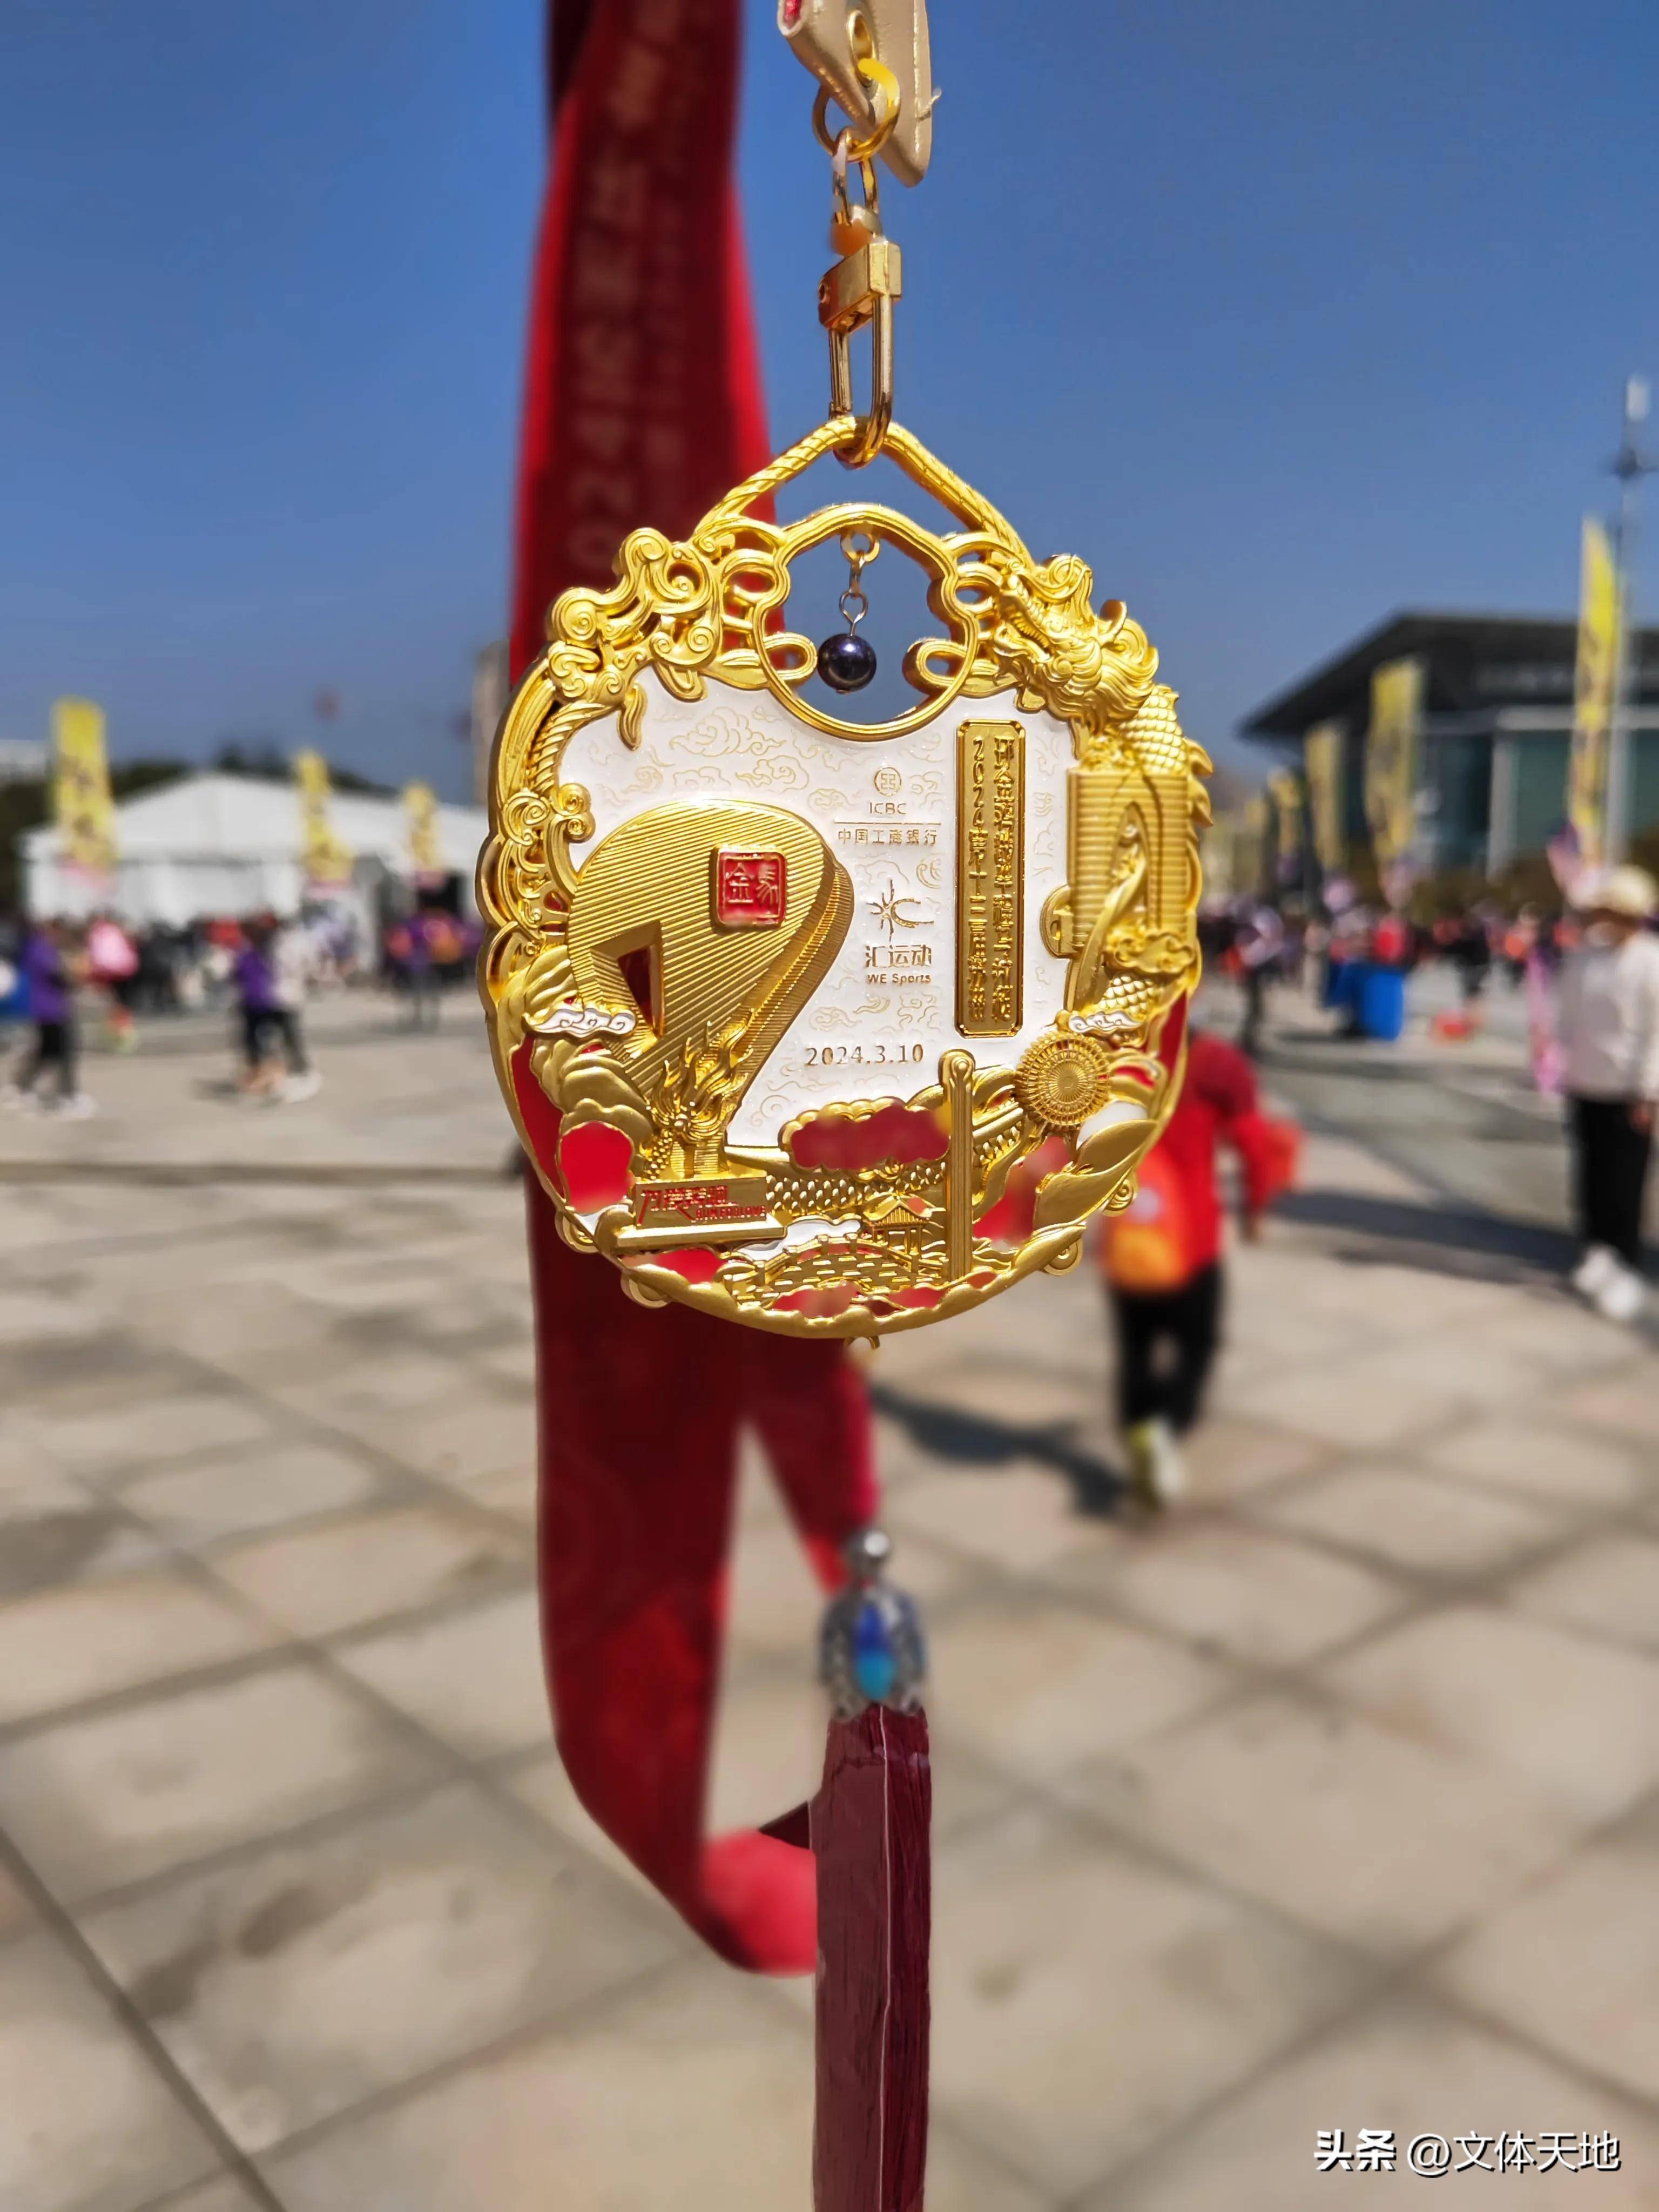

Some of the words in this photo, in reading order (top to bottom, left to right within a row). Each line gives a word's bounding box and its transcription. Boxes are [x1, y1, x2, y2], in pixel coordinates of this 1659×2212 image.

[869, 801, 907, 815] ICBC
[838, 828, 938, 846] 中国工商银行
[865, 945, 932, 968] 汇运动
[867, 973, 887, 984] WE
[892, 973, 931, 987] Sports
[804, 1043, 924, 1067] 2024.3.10
